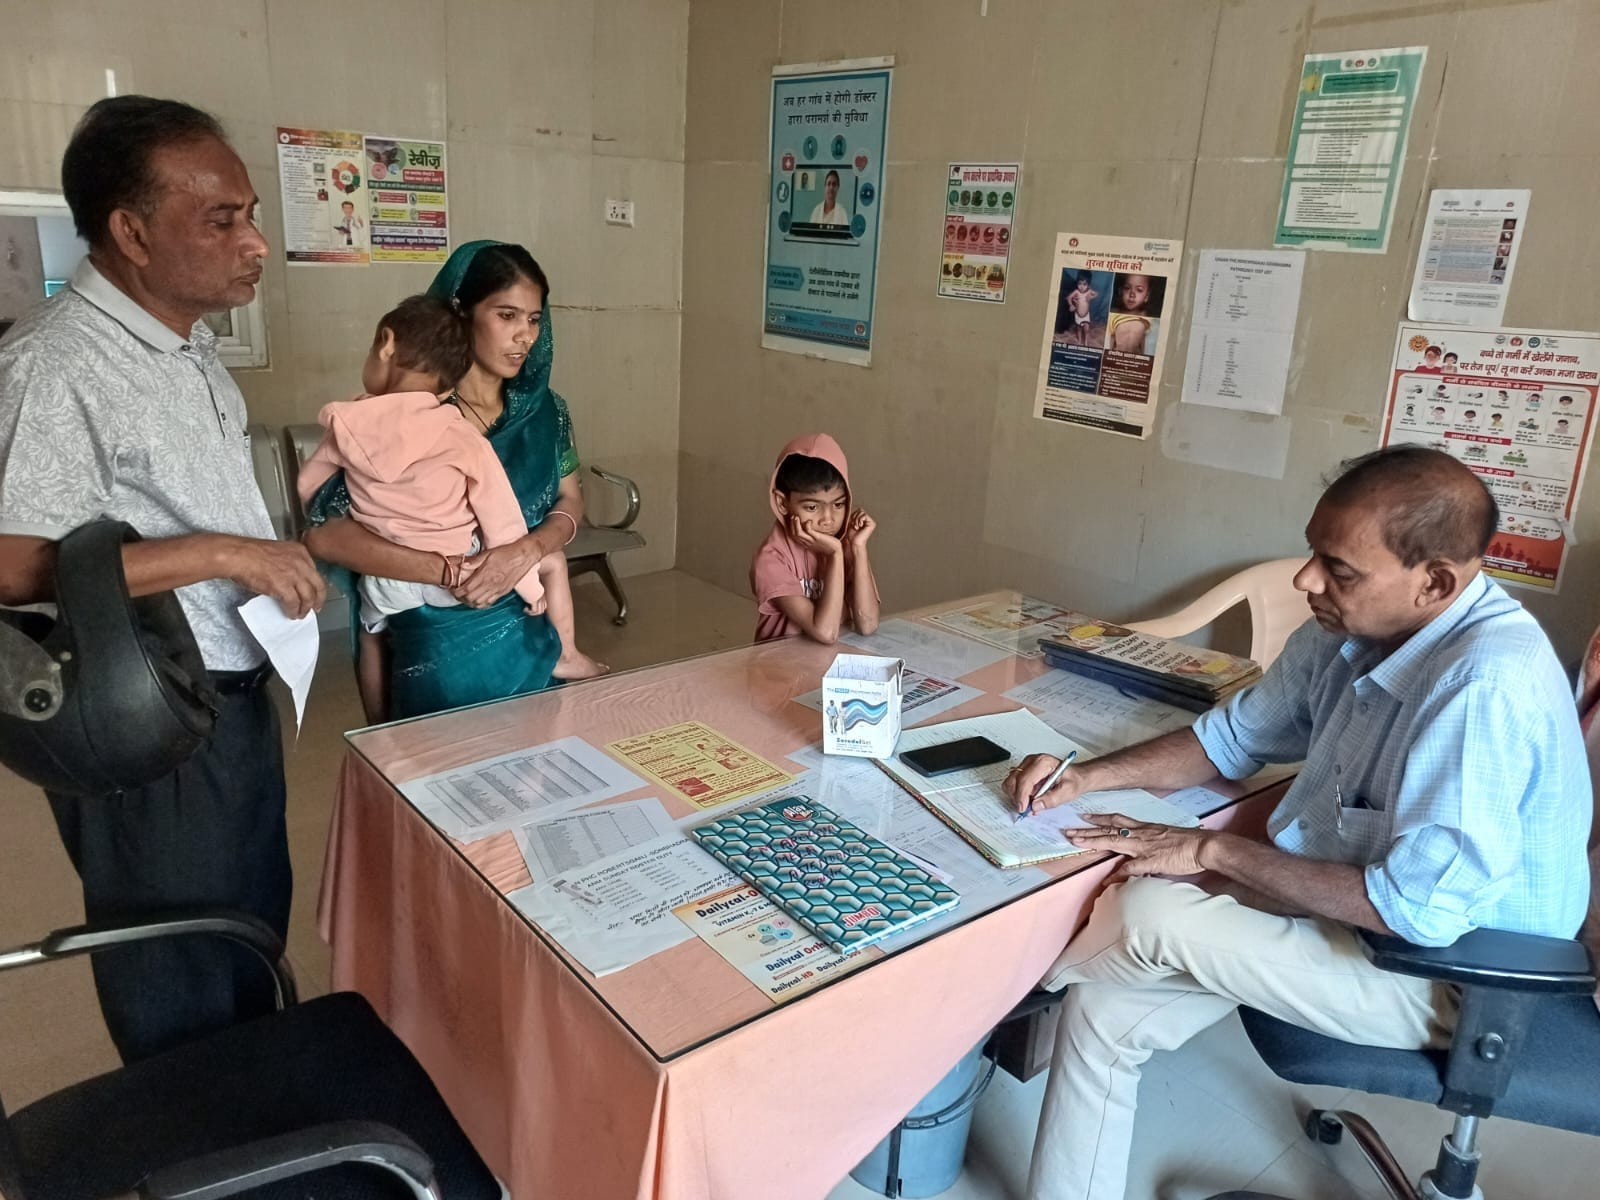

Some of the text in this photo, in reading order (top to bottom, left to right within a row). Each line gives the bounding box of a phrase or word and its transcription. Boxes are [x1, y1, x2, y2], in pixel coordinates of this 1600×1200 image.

[1106, 259, 1128, 271] सूचित
[1495, 348, 1504, 359] तो
[1460, 362, 1469, 370] पर
[1470, 361, 1483, 371] तेज
[843, 905, 881, 928] JUMBO
[765, 950, 804, 972] Dailycal
